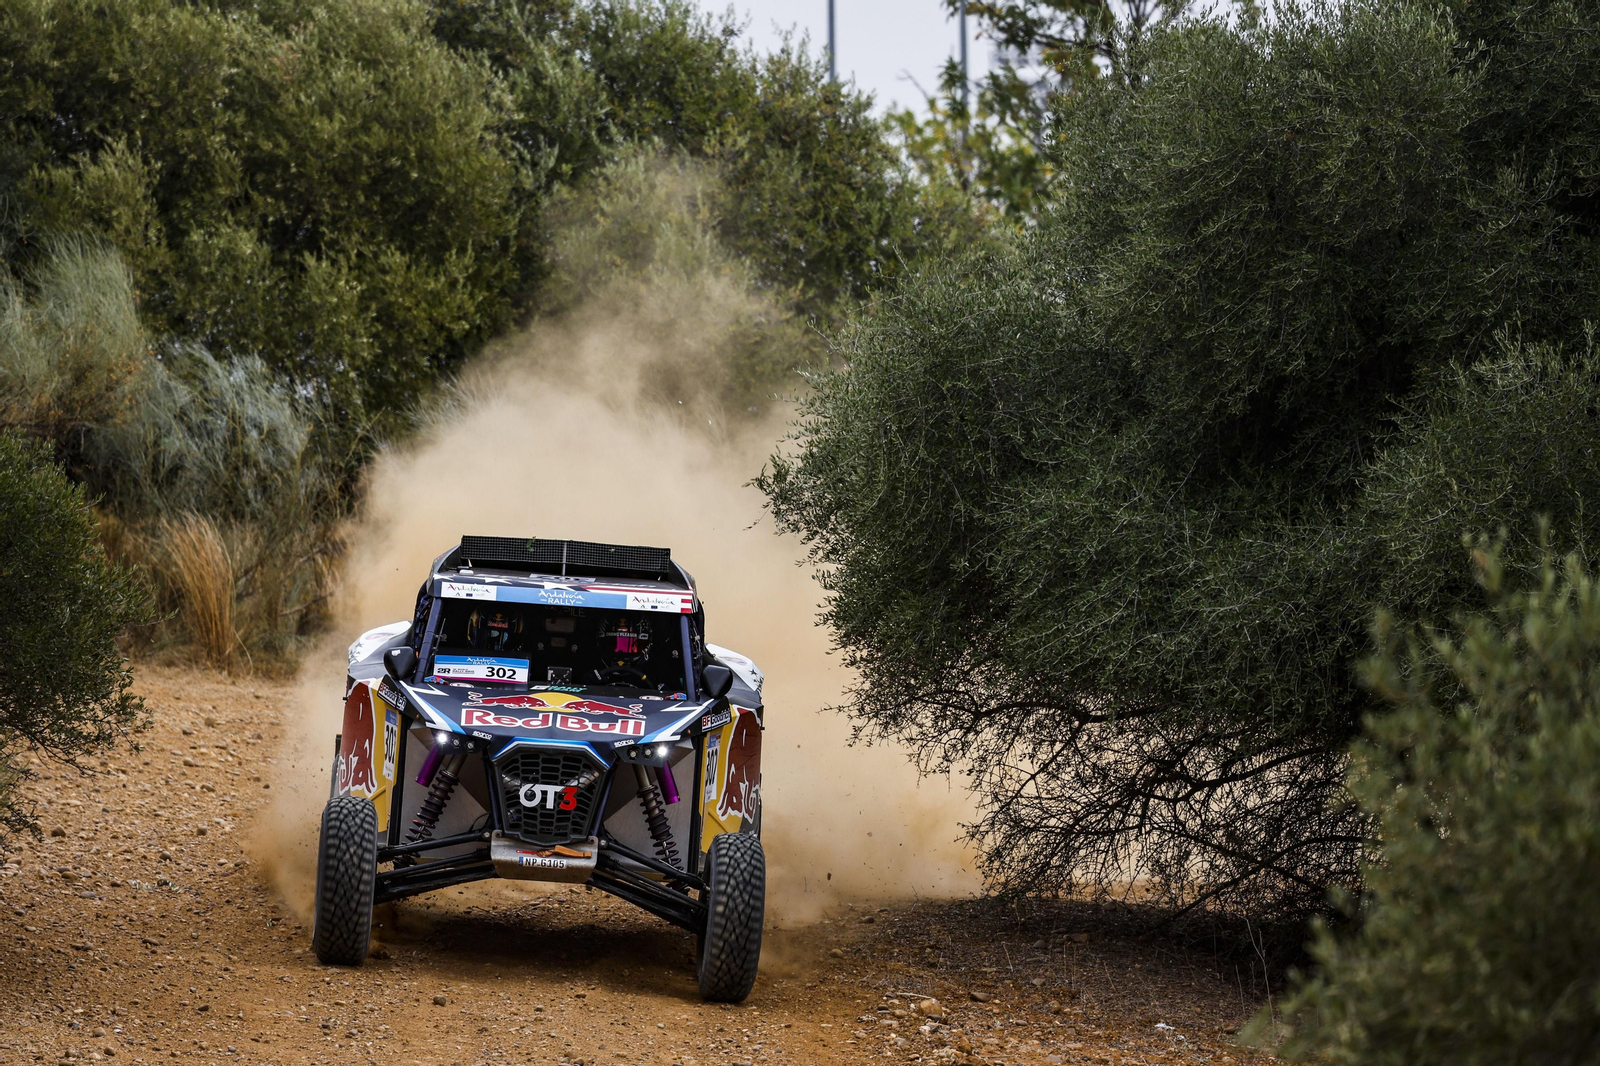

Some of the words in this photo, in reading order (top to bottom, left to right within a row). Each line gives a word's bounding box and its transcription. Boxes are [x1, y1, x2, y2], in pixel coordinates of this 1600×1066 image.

[485, 666, 517, 680] 302
[461, 708, 553, 729] Red
[557, 714, 646, 737] Bull
[525, 857, 538, 867] NP
